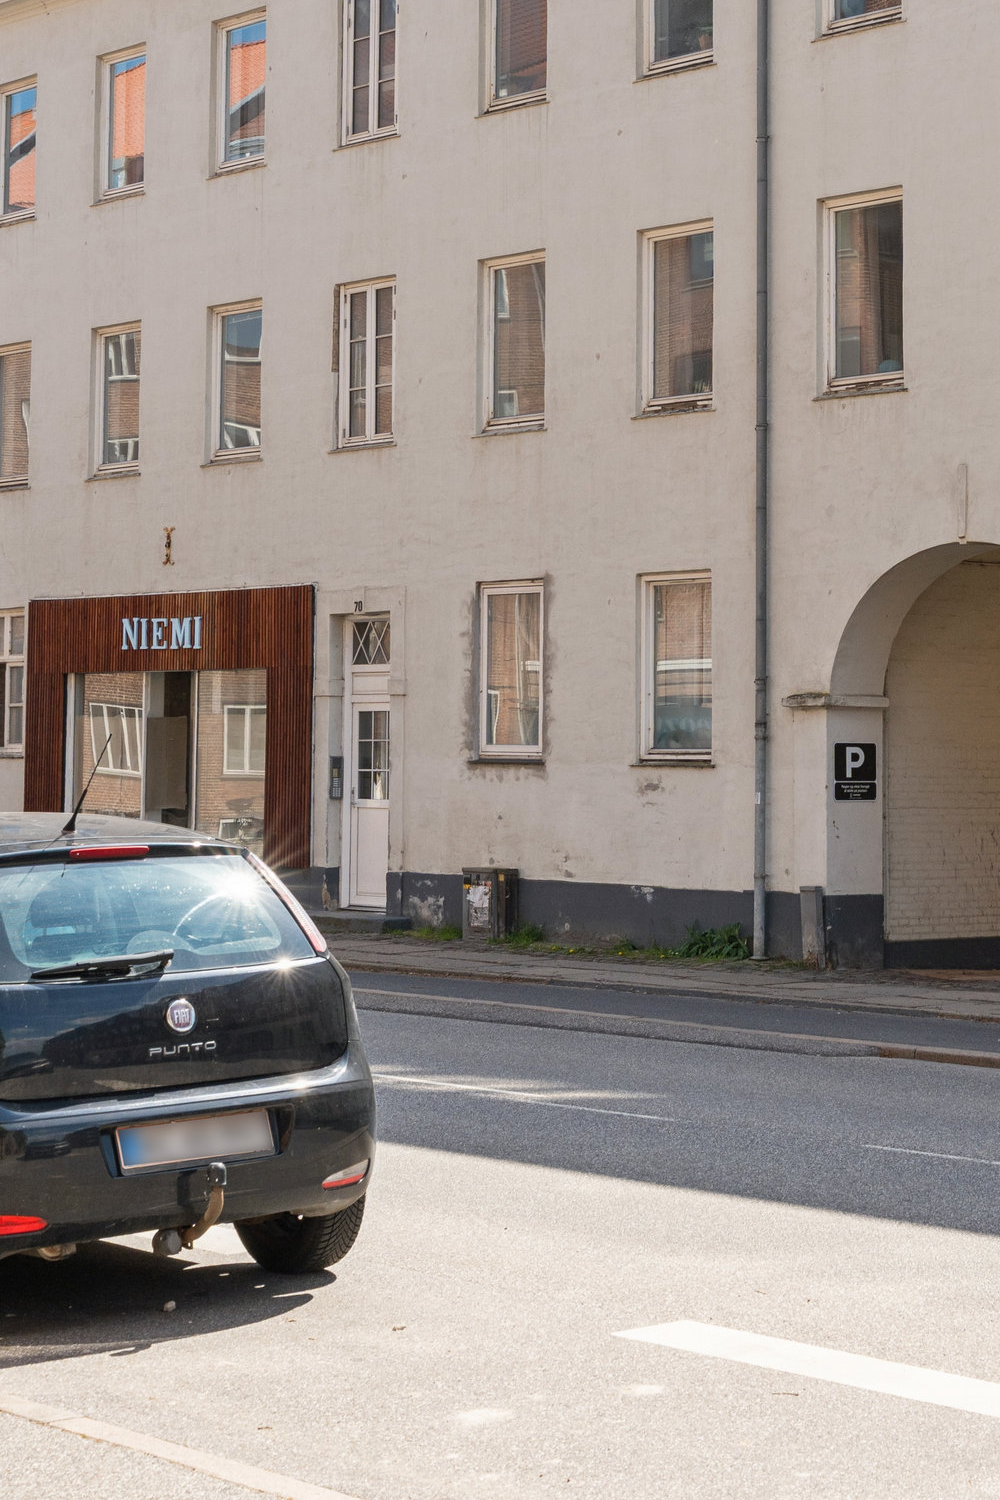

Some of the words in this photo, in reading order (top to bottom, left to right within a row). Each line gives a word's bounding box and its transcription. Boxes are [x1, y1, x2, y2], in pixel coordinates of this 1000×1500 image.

[354, 600, 363, 612] 70
[121, 616, 203, 651] NIEMI
[846, 746, 865, 778] P
[173, 1008, 190, 1024] FIAT
[148, 1040, 217, 1057] PUNTO
